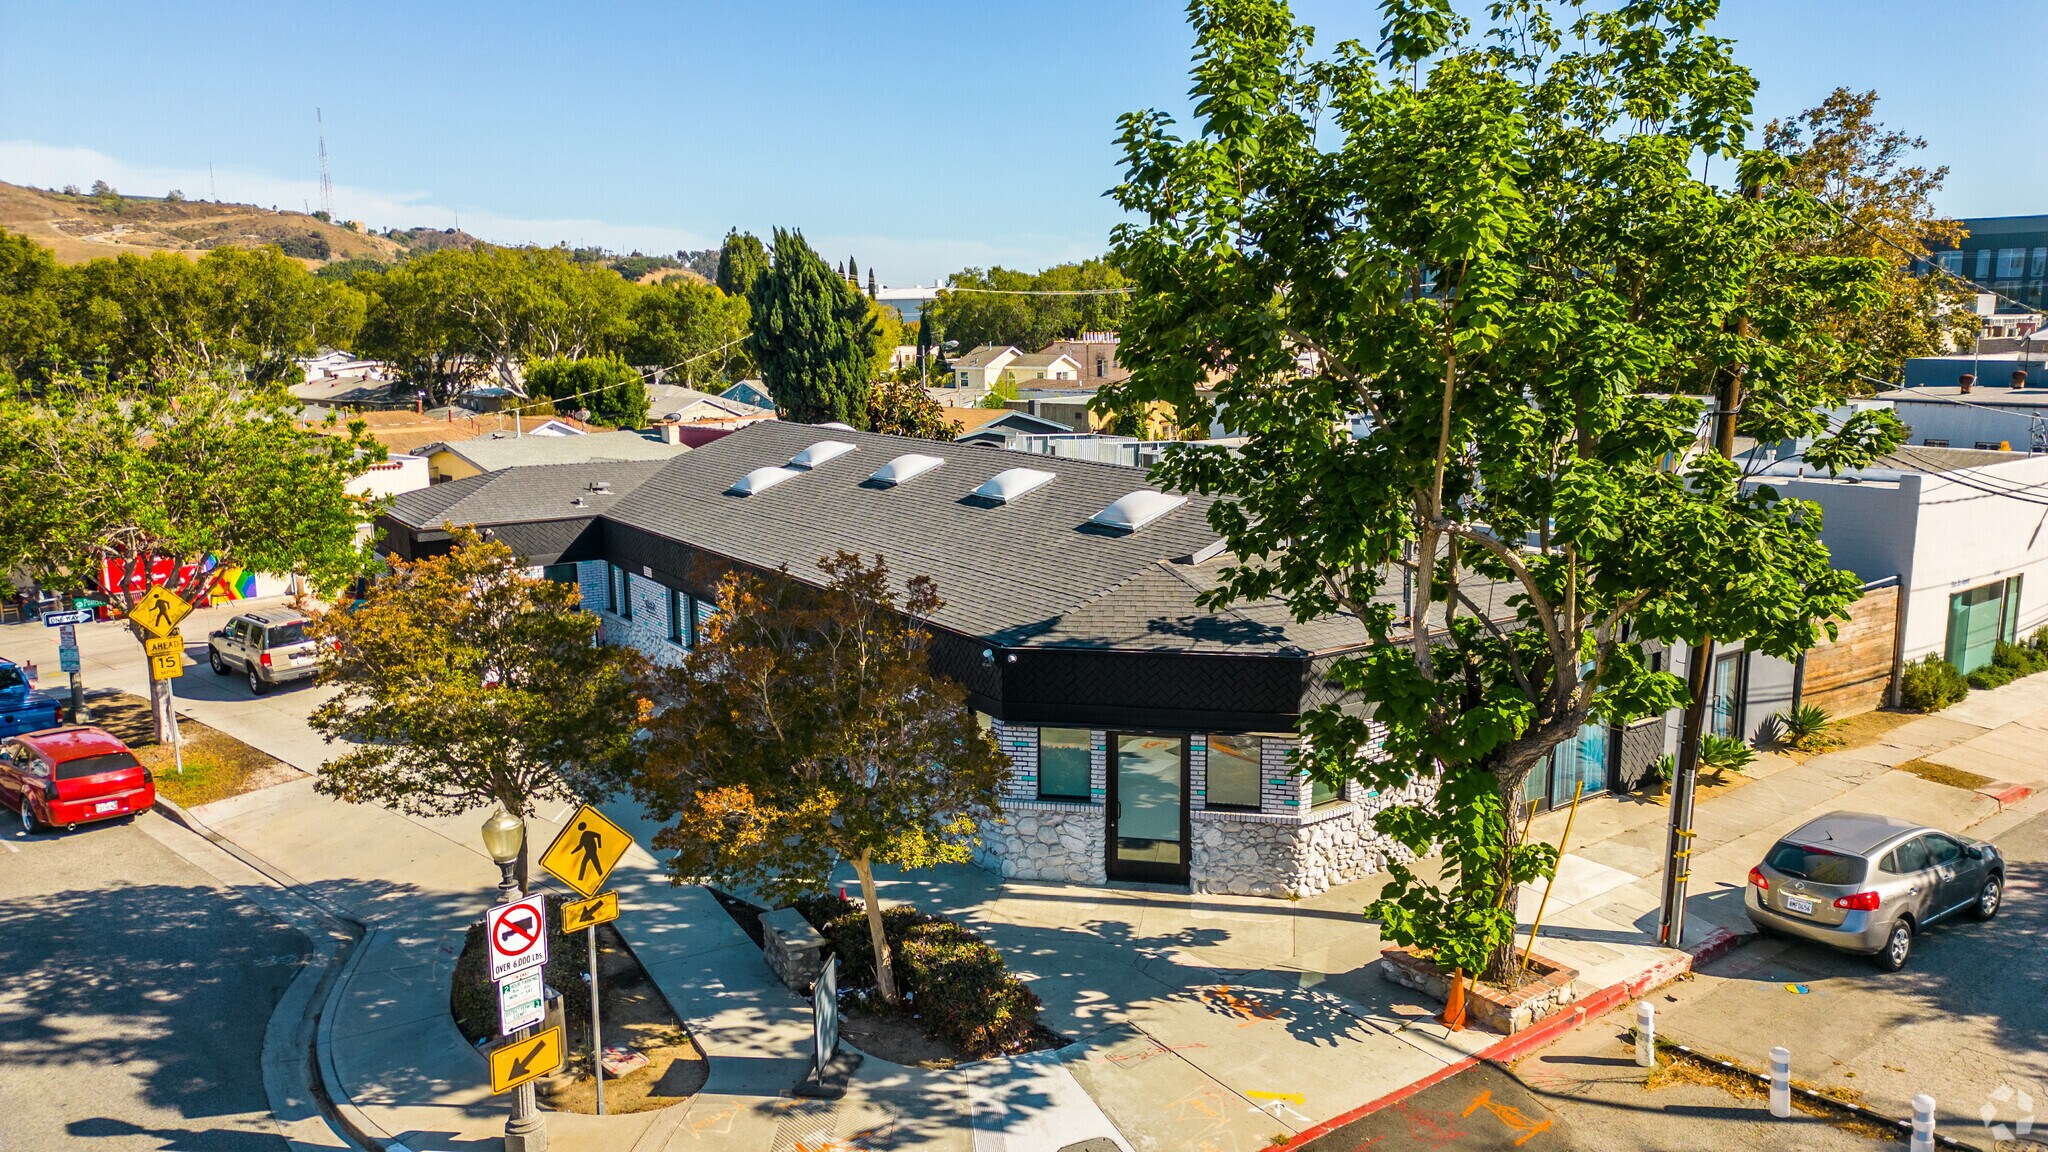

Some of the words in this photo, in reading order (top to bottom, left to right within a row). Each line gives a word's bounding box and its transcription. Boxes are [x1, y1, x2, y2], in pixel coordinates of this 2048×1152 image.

[152, 641, 179, 651] AHEAD
[159, 656, 176, 669] 15
[495, 962, 511, 975] OVER
